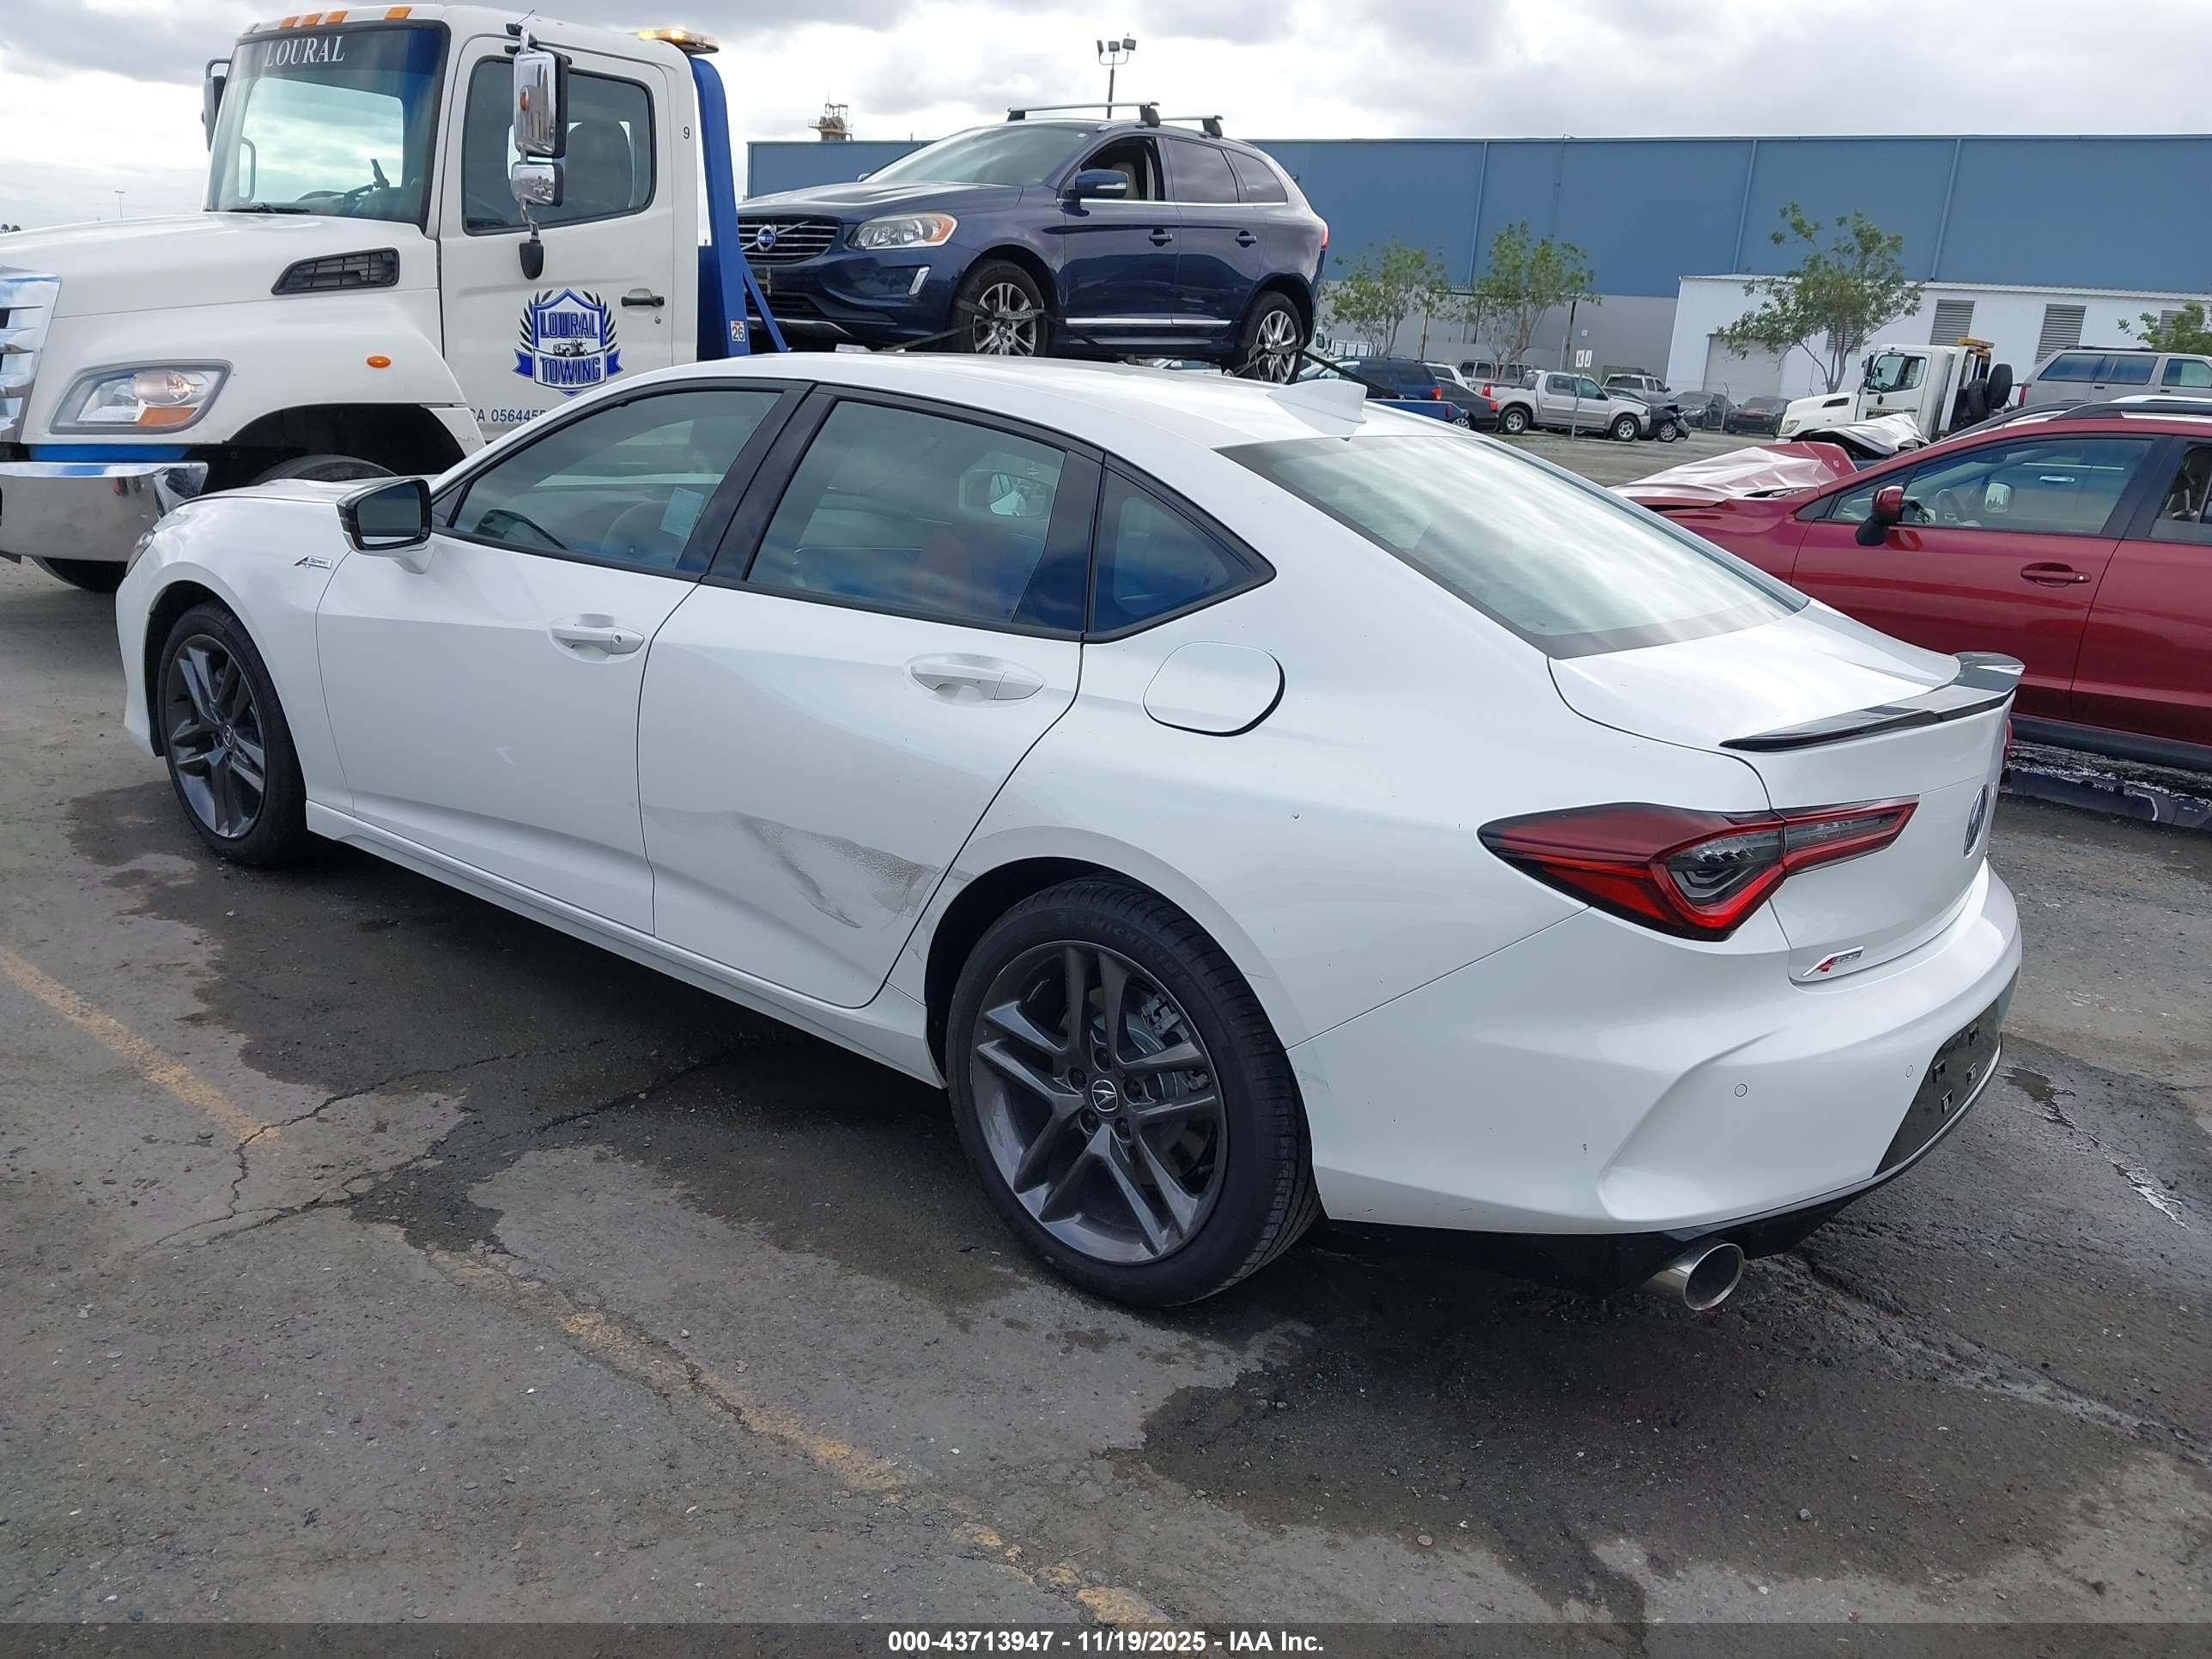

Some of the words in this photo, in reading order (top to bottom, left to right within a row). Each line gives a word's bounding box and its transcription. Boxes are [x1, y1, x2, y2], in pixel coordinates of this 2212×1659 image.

[264, 35, 345, 67] LOURAL
[683, 125, 690, 140] 9
[539, 312, 599, 338] LOURAL
[732, 326, 744, 341] 26
[539, 356, 601, 385] TOWING
